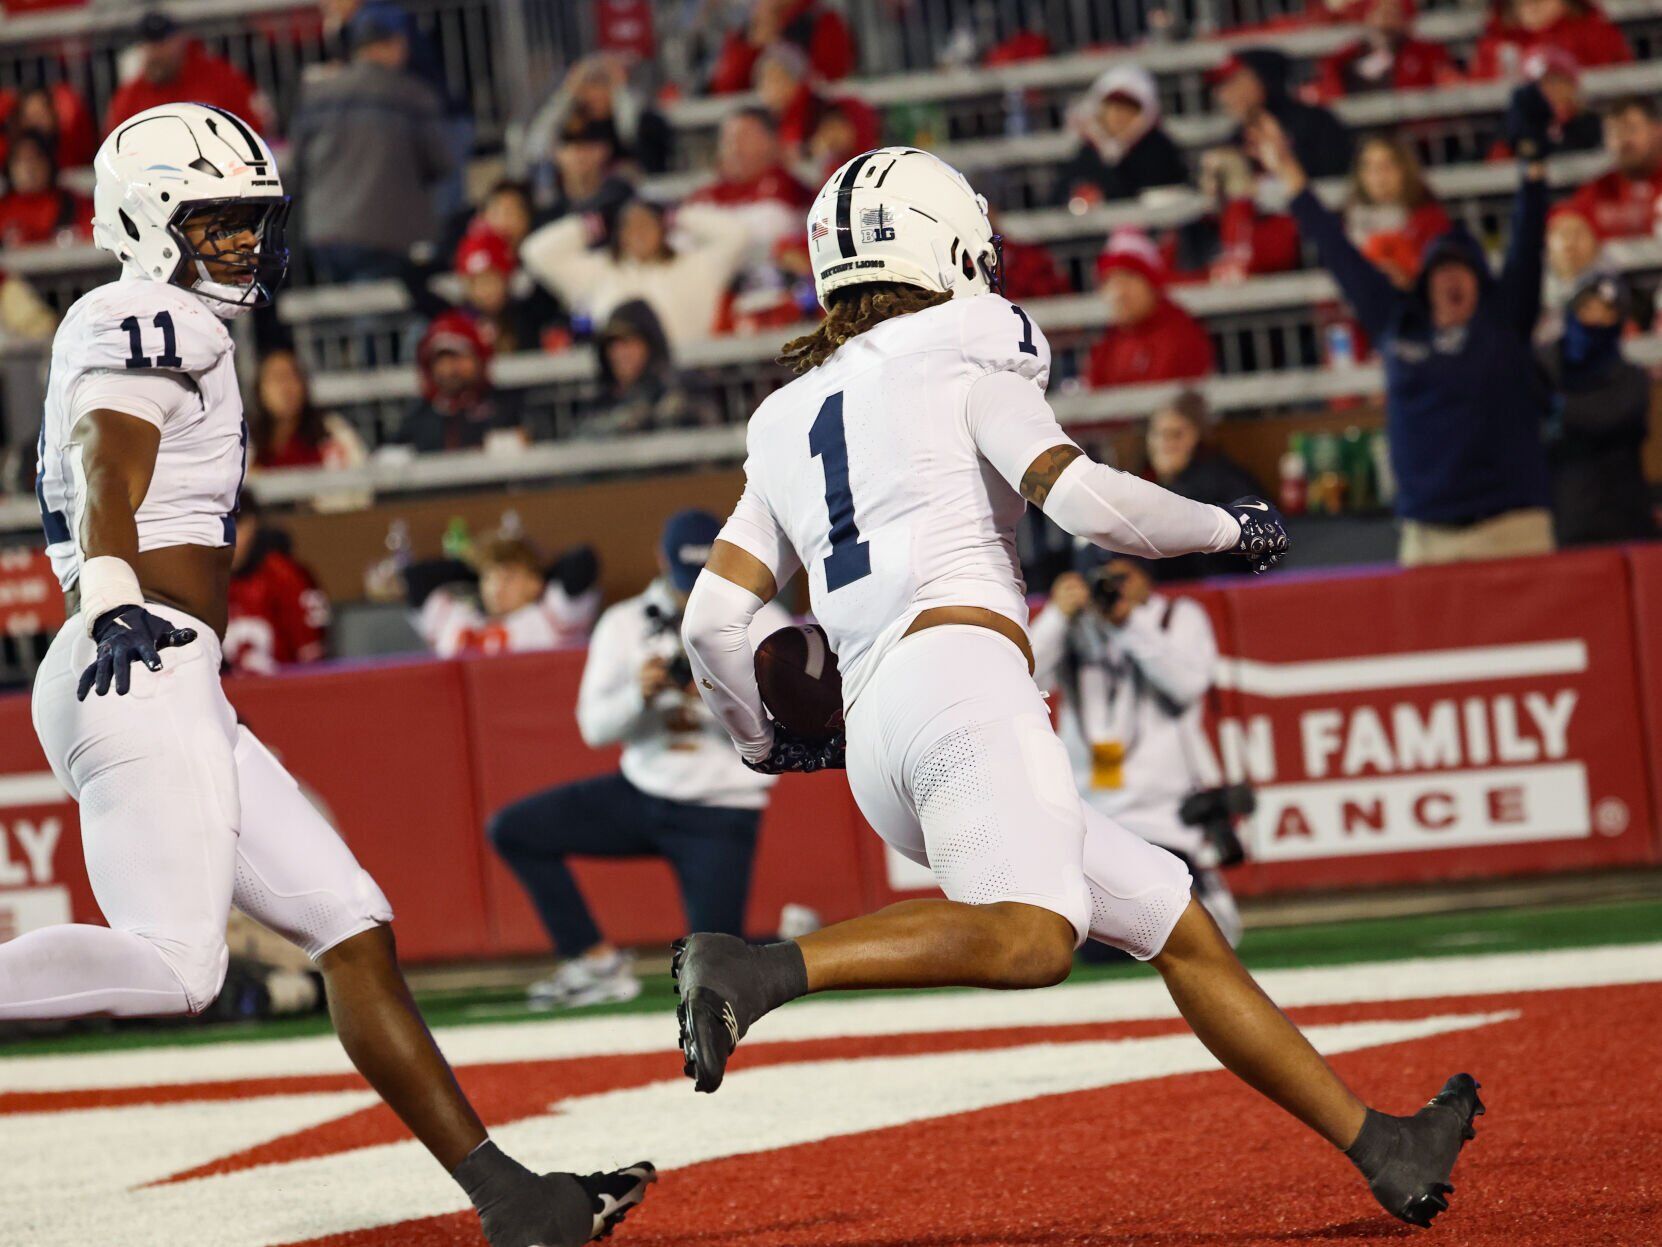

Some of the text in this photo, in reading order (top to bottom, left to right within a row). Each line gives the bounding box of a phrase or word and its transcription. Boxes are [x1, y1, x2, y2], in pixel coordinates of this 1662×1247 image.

[120, 310, 183, 369] 11
[1010, 304, 1039, 358] 1
[808, 390, 872, 594] 1
[1302, 689, 1578, 778] FAMILY
[1273, 786, 1527, 839] ANCE
